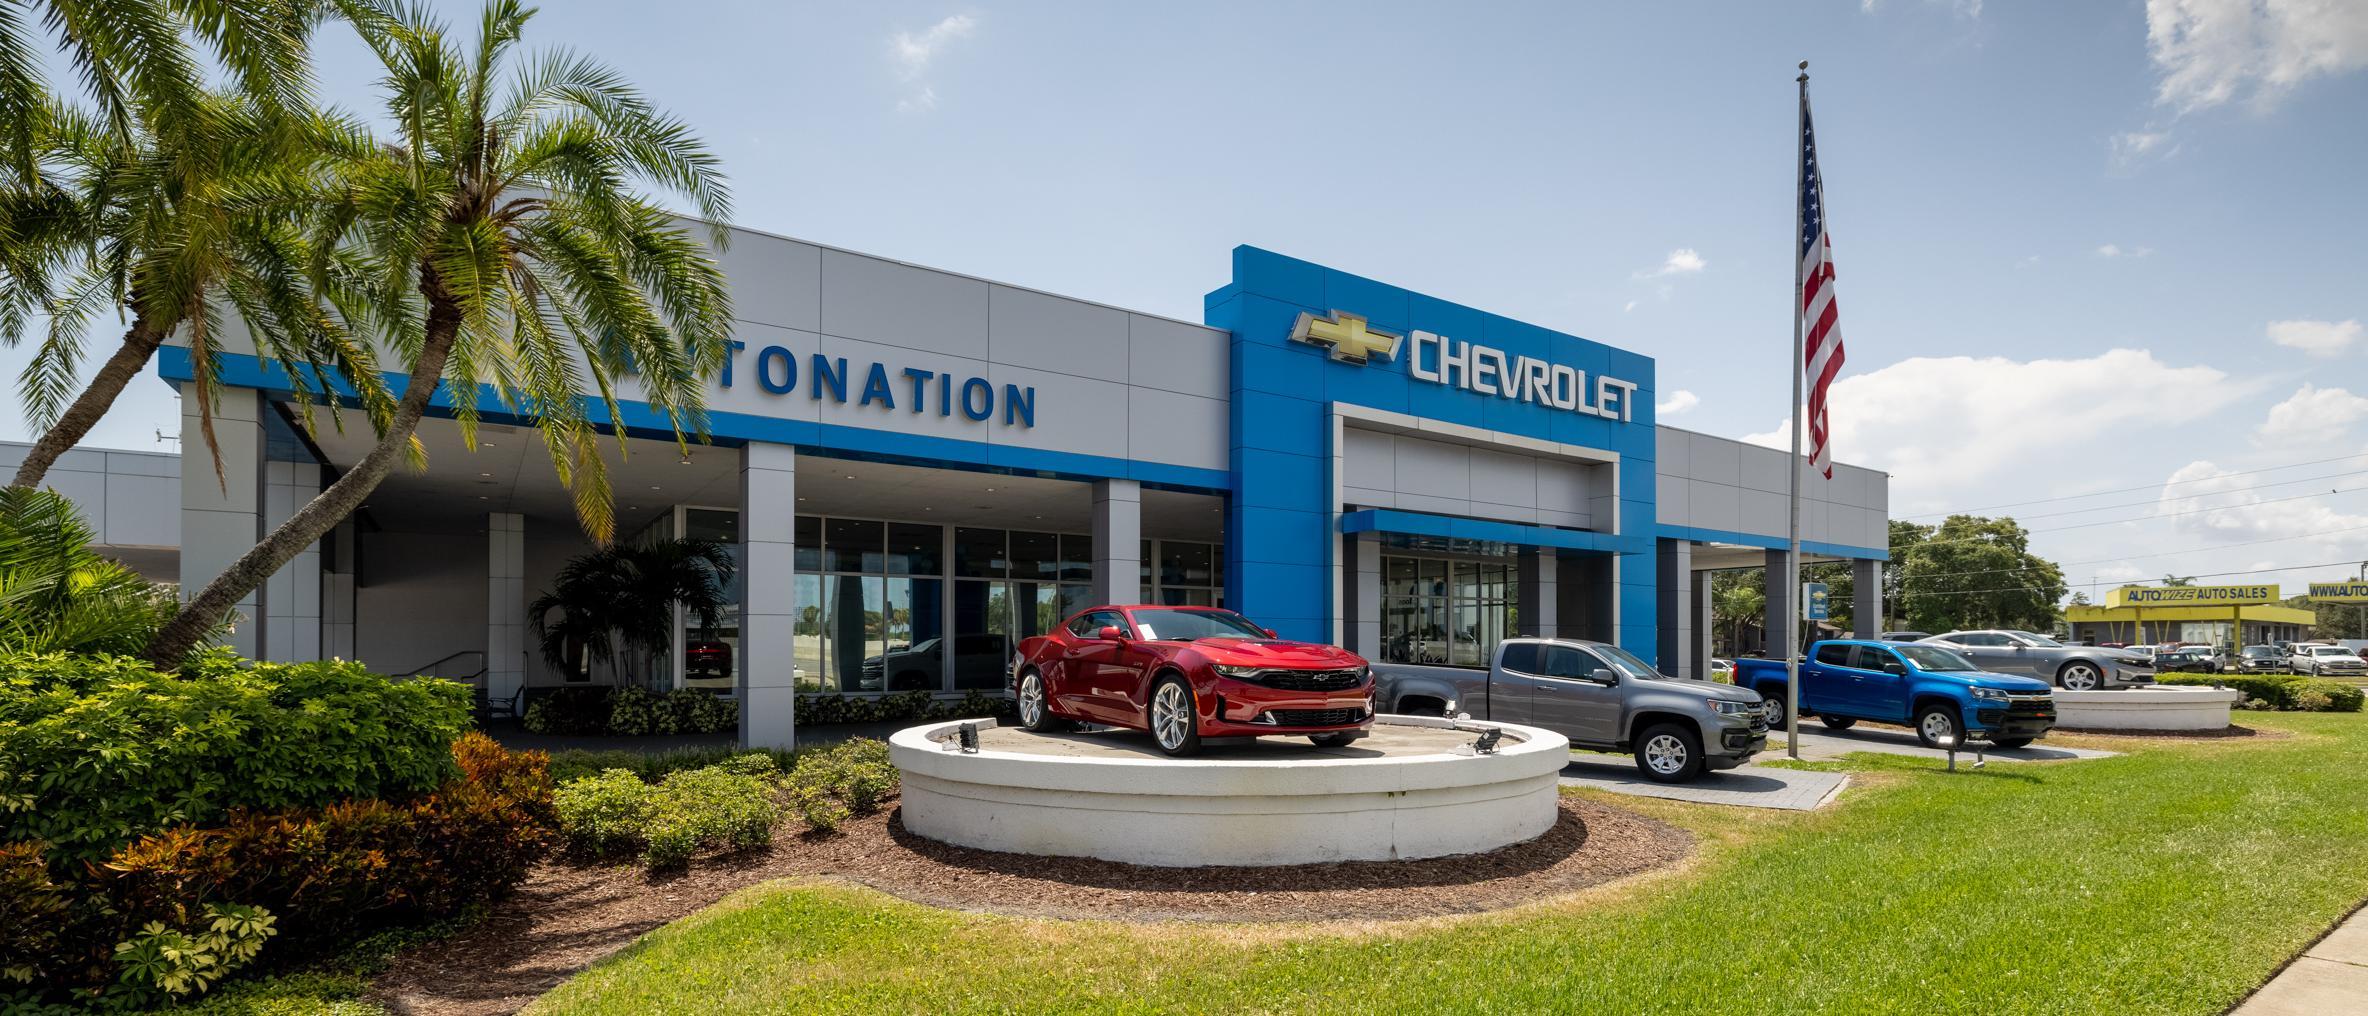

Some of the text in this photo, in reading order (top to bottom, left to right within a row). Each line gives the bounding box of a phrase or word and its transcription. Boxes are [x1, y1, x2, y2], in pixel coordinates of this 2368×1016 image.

[600, 325, 1035, 428] TONATION
[1408, 330, 1637, 423] CHEVROLET
[2197, 589, 2227, 600] AUTO
[2229, 587, 2268, 599] SALES
